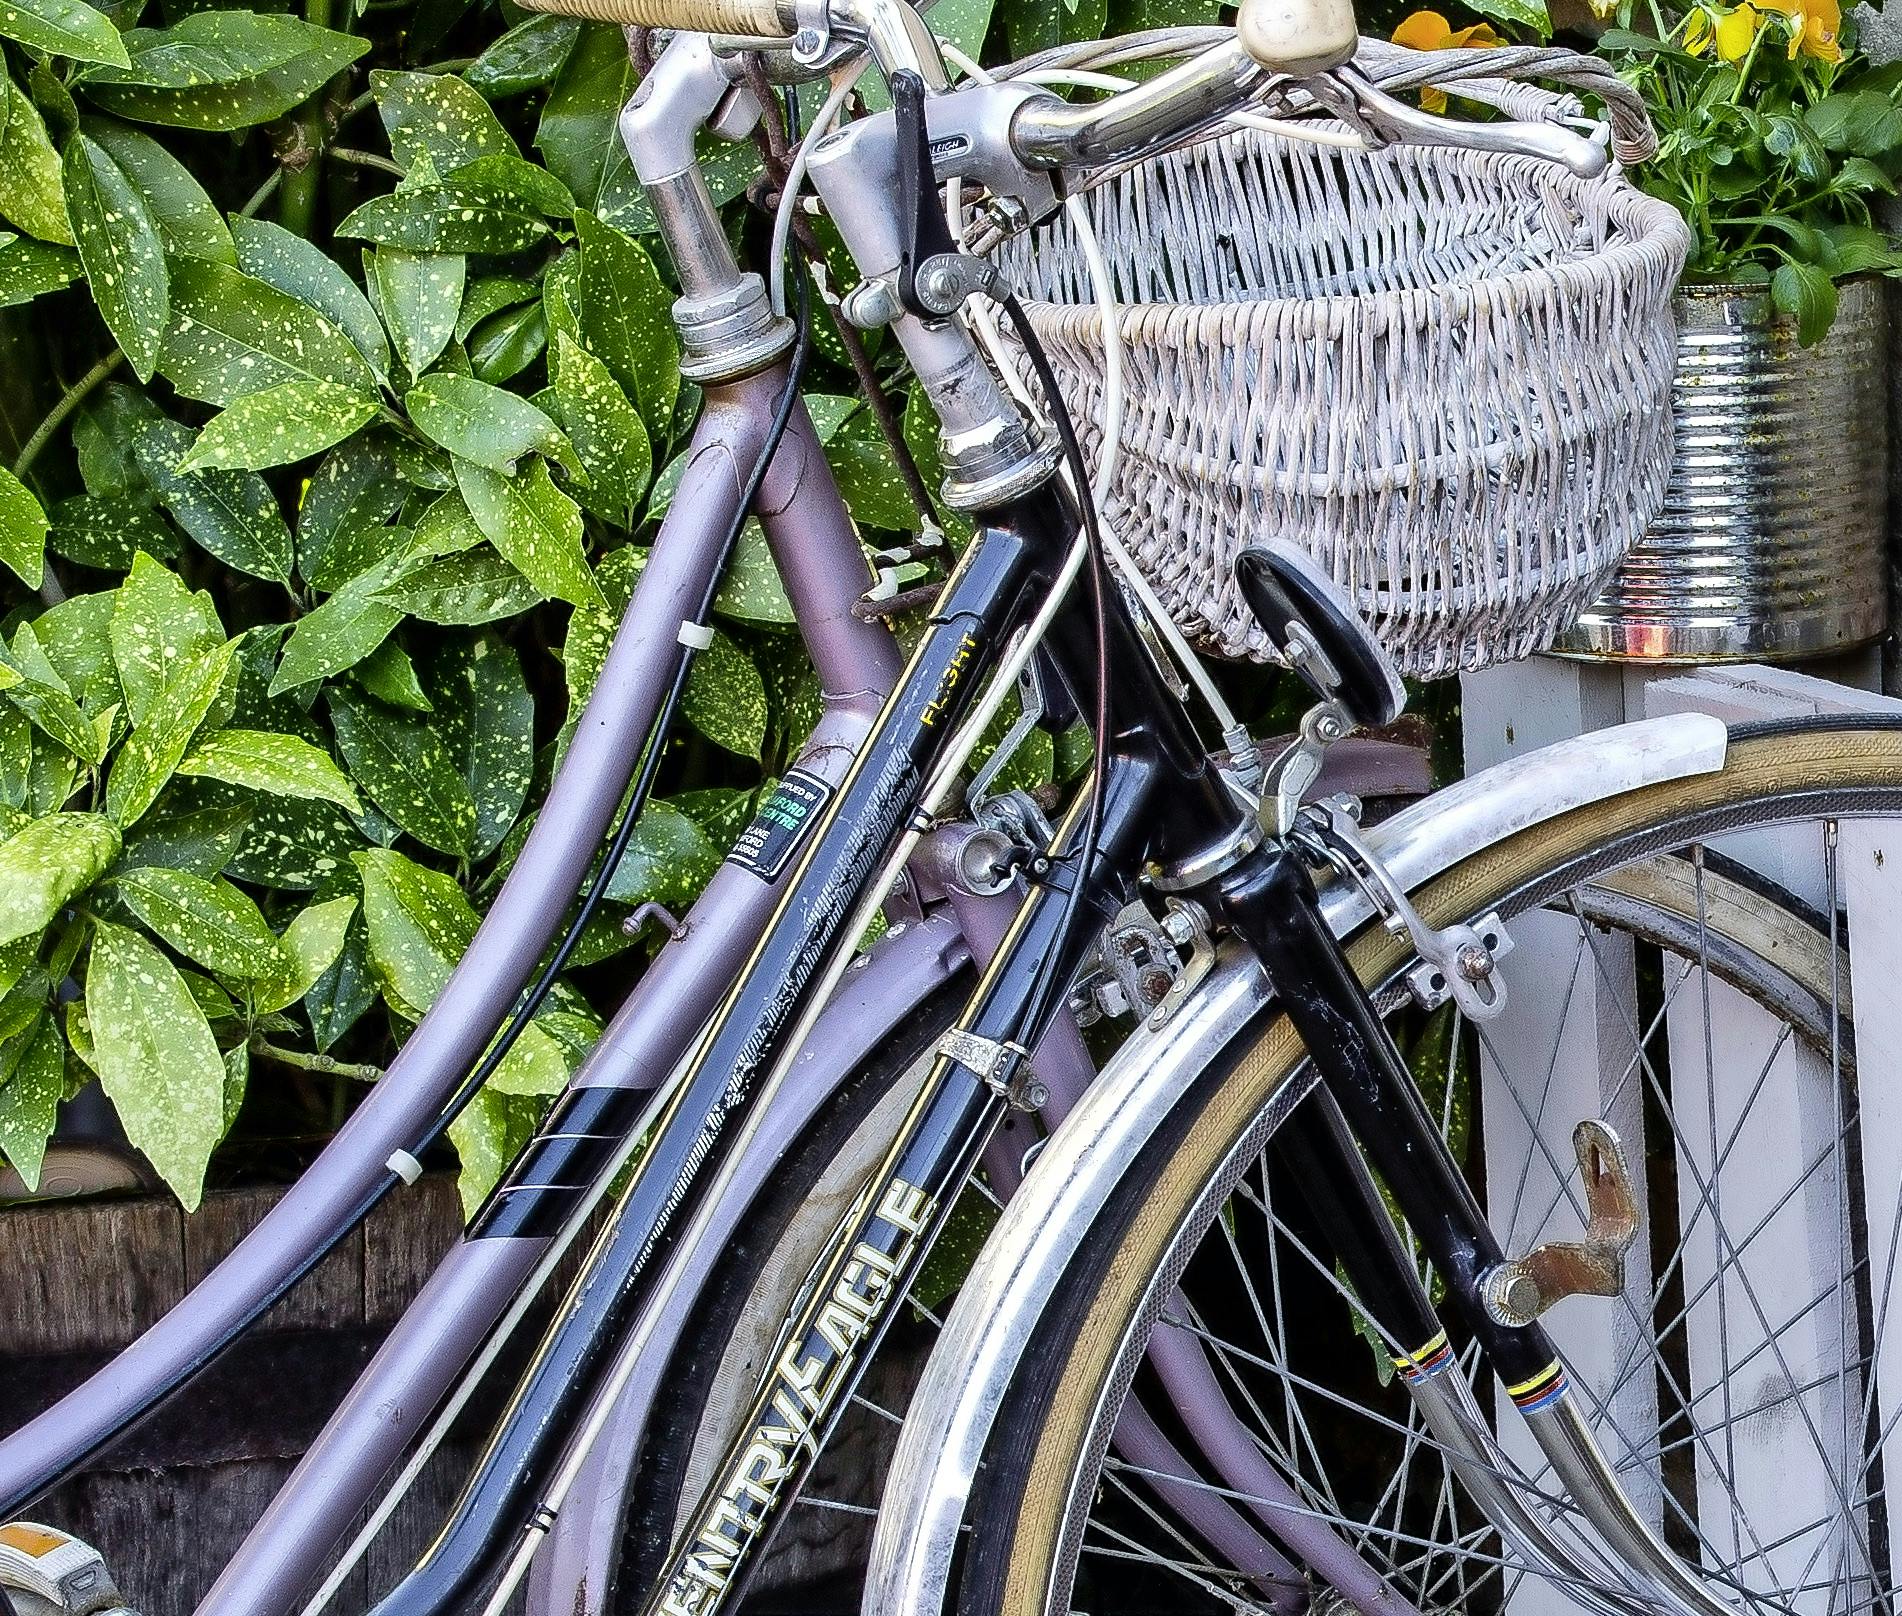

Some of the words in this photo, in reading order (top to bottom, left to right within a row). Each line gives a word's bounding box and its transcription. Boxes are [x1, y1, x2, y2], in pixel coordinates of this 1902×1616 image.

[929, 139, 959, 154] LEIGH
[804, 791, 818, 802] BY
[763, 805, 800, 831] ENTRE
[777, 1176, 940, 1423] EAGLE
